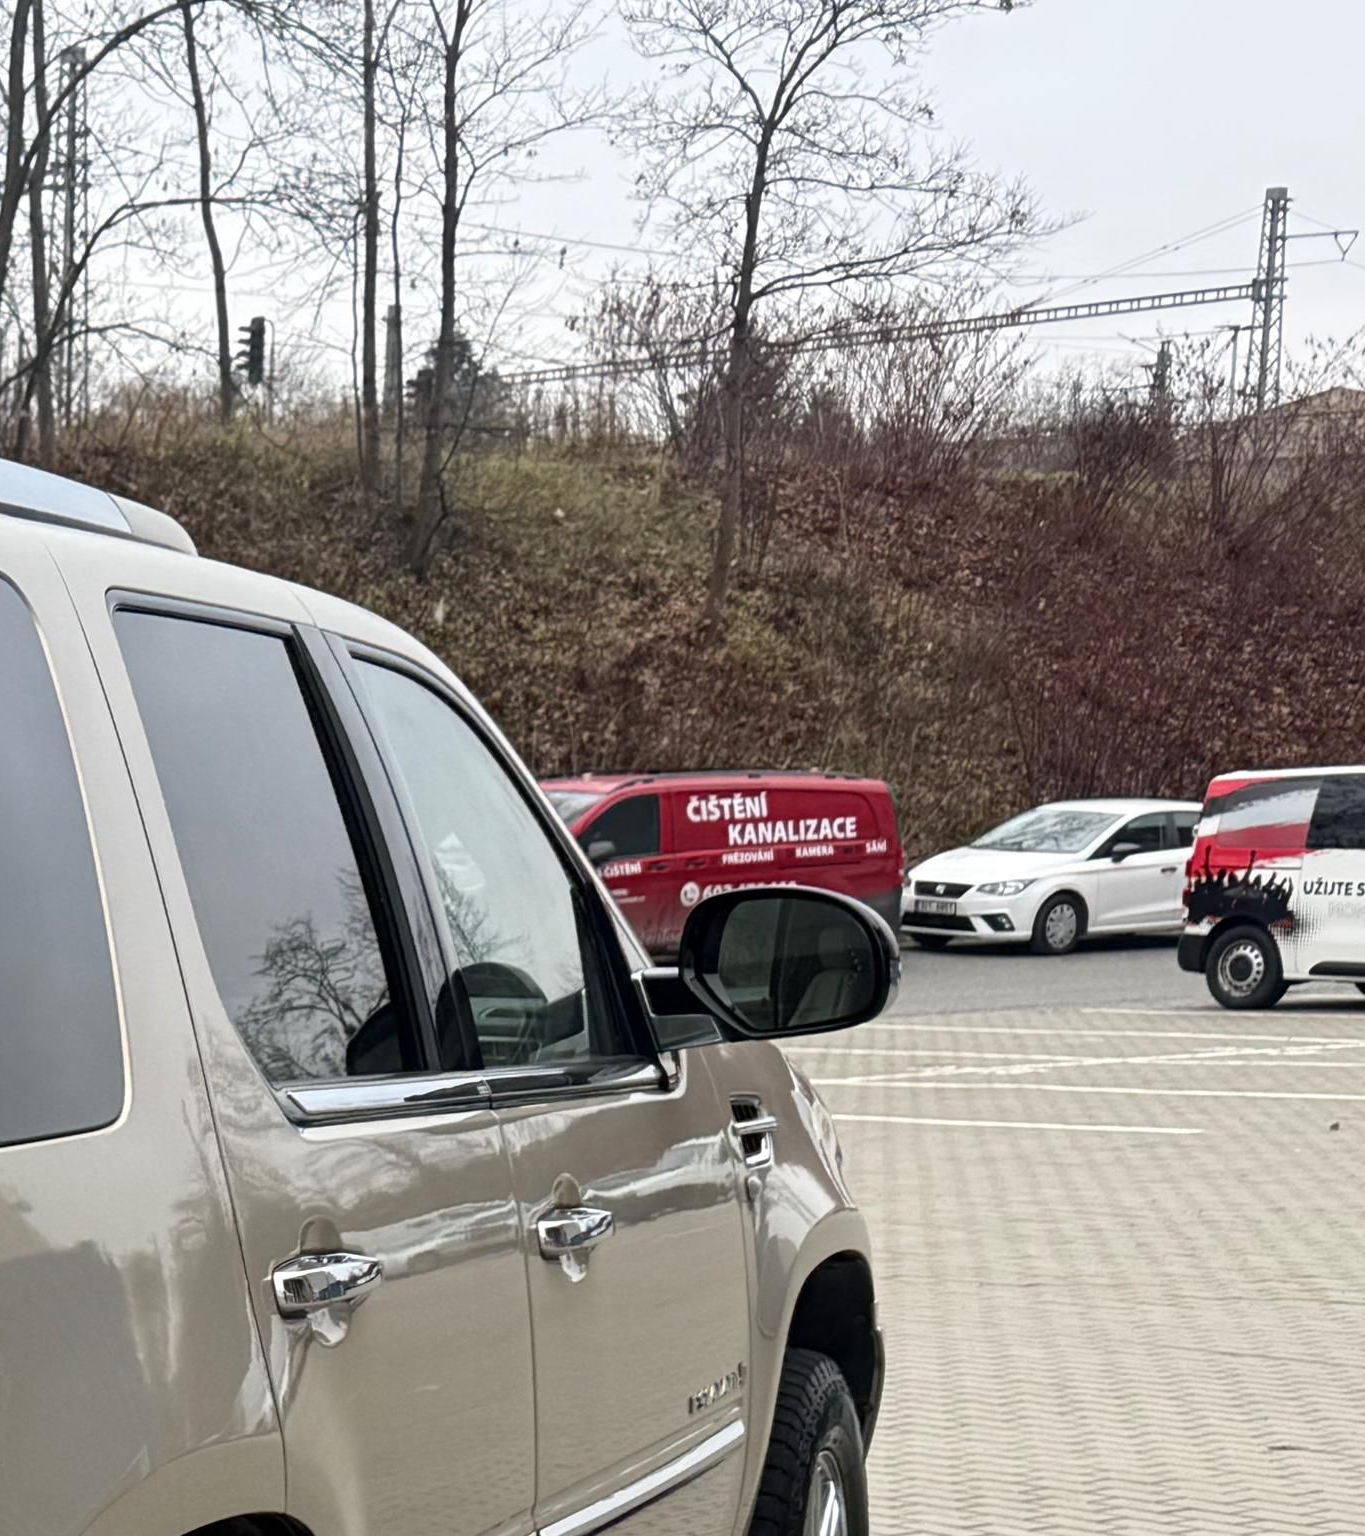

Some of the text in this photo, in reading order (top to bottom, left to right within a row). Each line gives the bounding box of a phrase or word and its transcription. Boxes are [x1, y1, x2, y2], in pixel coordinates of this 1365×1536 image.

[686, 790, 768, 823] ČIŠTĚNÍ
[727, 816, 858, 846] KANALIZACE
[795, 844, 835, 859] KAMERA
[1303, 877, 1353, 897] UŽIJTE
